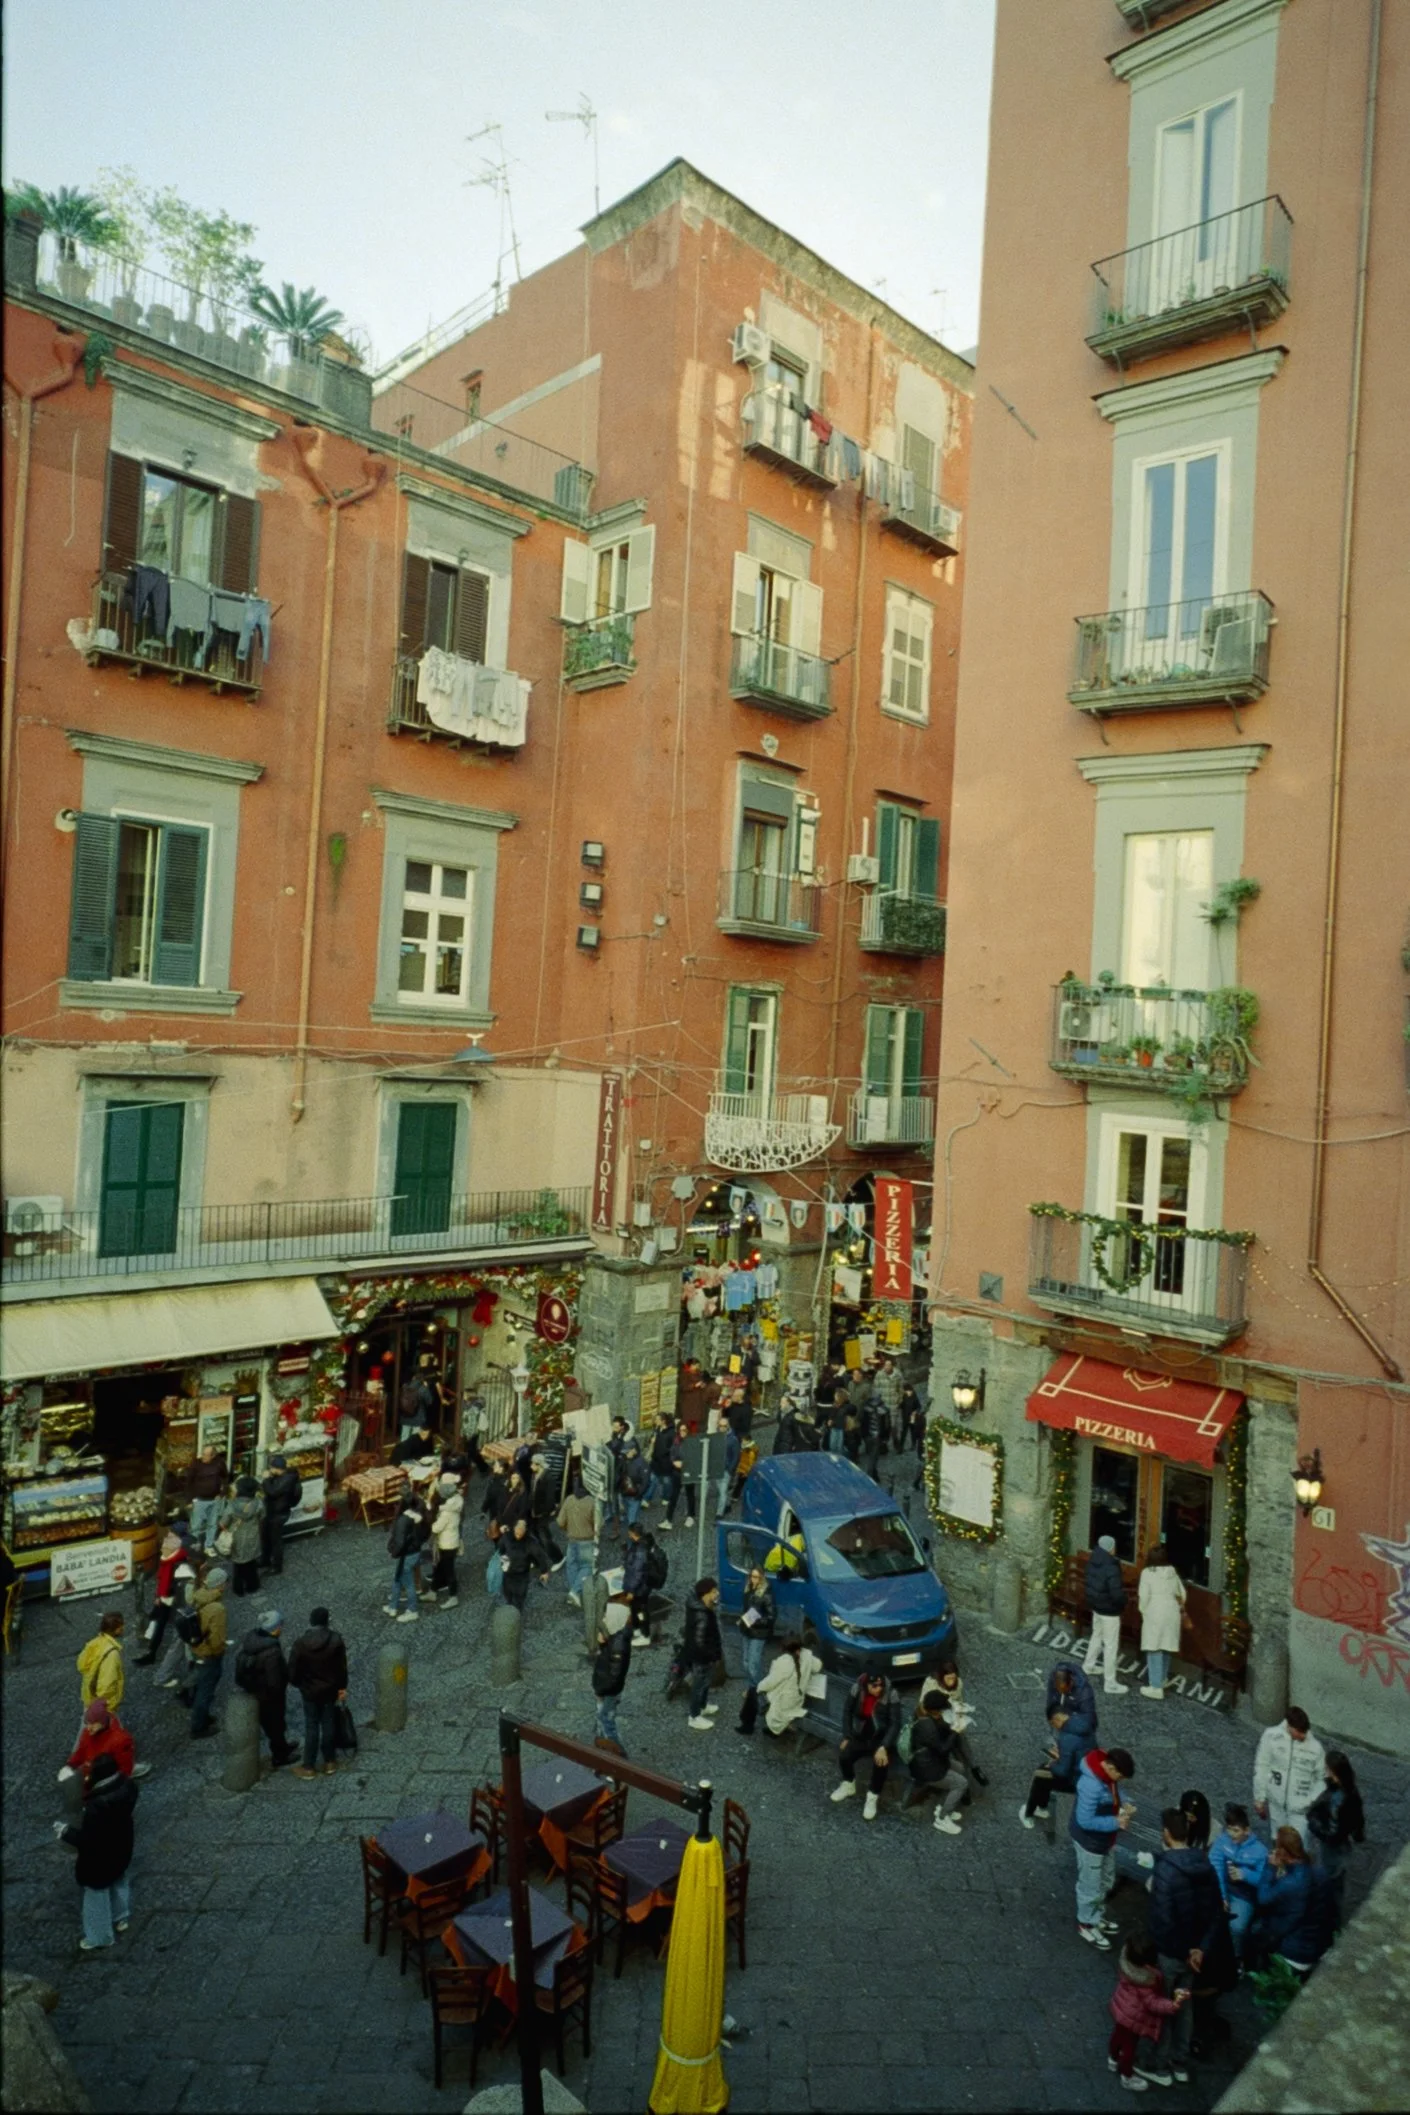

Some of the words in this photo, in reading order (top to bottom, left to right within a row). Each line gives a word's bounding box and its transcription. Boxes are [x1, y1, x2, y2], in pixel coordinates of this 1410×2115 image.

[597, 1081, 616, 1225] TRATTORIA
[883, 1184, 901, 1290] PIZZERIA
[1075, 1415, 1157, 1450] PIZZERIA
[89, 1552, 127, 1567] LANDIA
